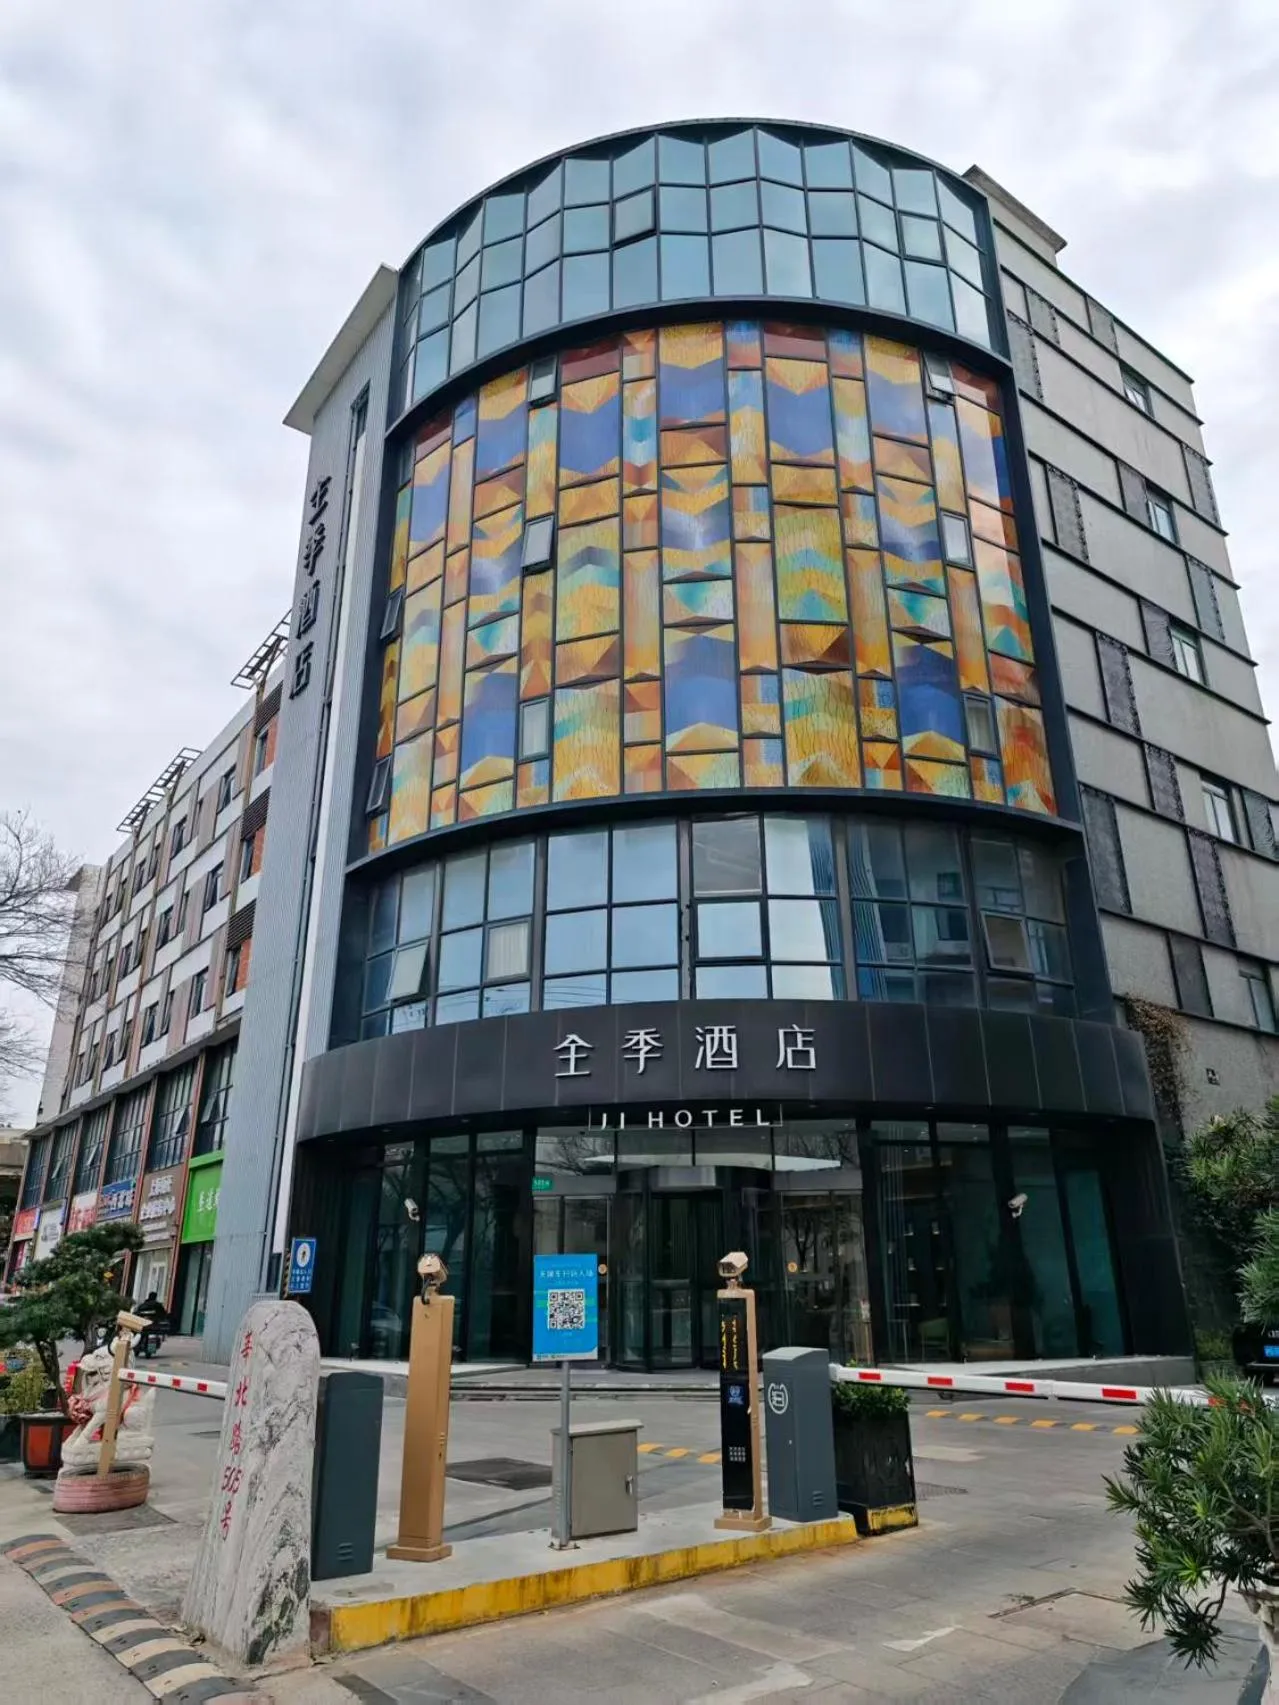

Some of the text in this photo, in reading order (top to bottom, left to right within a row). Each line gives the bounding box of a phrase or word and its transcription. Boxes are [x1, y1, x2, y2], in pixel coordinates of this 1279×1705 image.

[553, 1023, 817, 1078] 全季酒店
[601, 1108, 771, 1131] JI HOTEL
